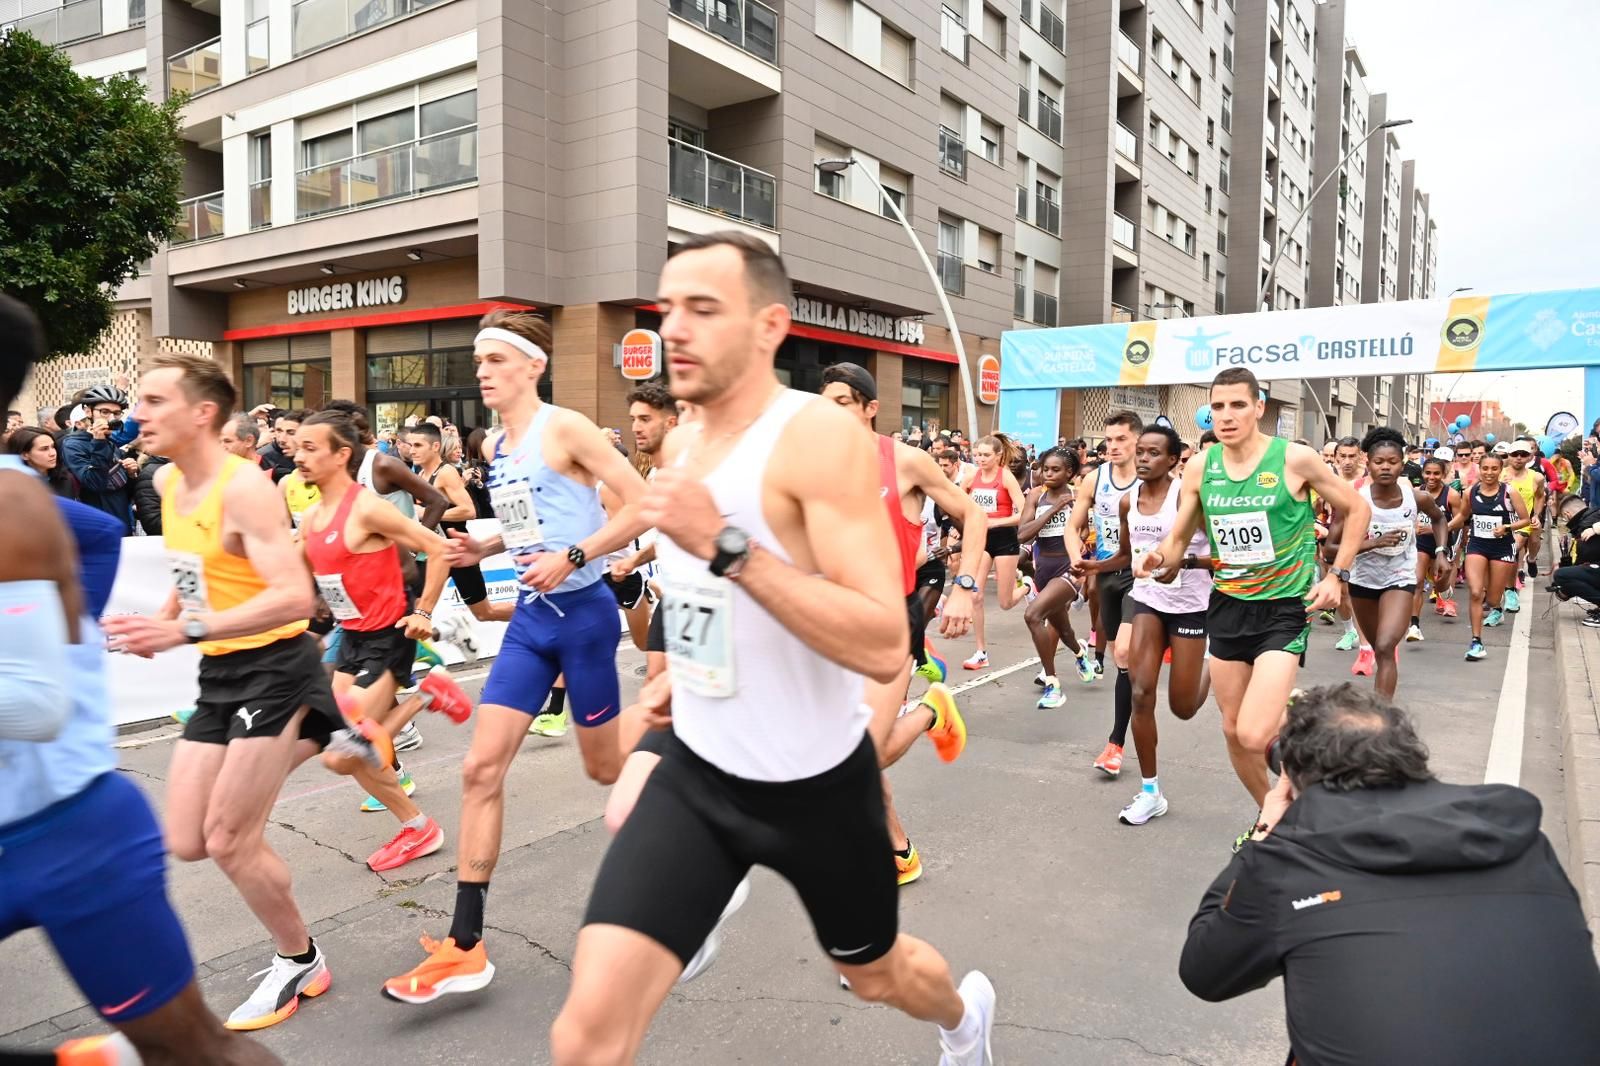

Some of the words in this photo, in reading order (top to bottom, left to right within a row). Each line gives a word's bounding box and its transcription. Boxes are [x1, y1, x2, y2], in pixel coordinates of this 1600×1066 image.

[287, 282, 353, 315] BURGER
[356, 275, 403, 307] KING
[790, 296, 848, 330] RRILLA
[849, 308, 894, 339] DESDE
[895, 318, 925, 345] 1954
[624, 346, 653, 355] BURGER
[1215, 342, 1300, 366] Facsa
[1317, 332, 1414, 360] CASTELLÓ
[624, 356, 653, 368] KING
[982, 381, 998, 393] KING
[974, 494, 993, 505] 2058
[1207, 493, 1276, 507] Huesca
[1476, 521, 1497, 530] 2061
[1106, 527, 1119, 540] 21
[1218, 526, 1262, 546] 2109
[1231, 544, 1252, 552] JAIME
[1178, 627, 1204, 635] KIPRUN
